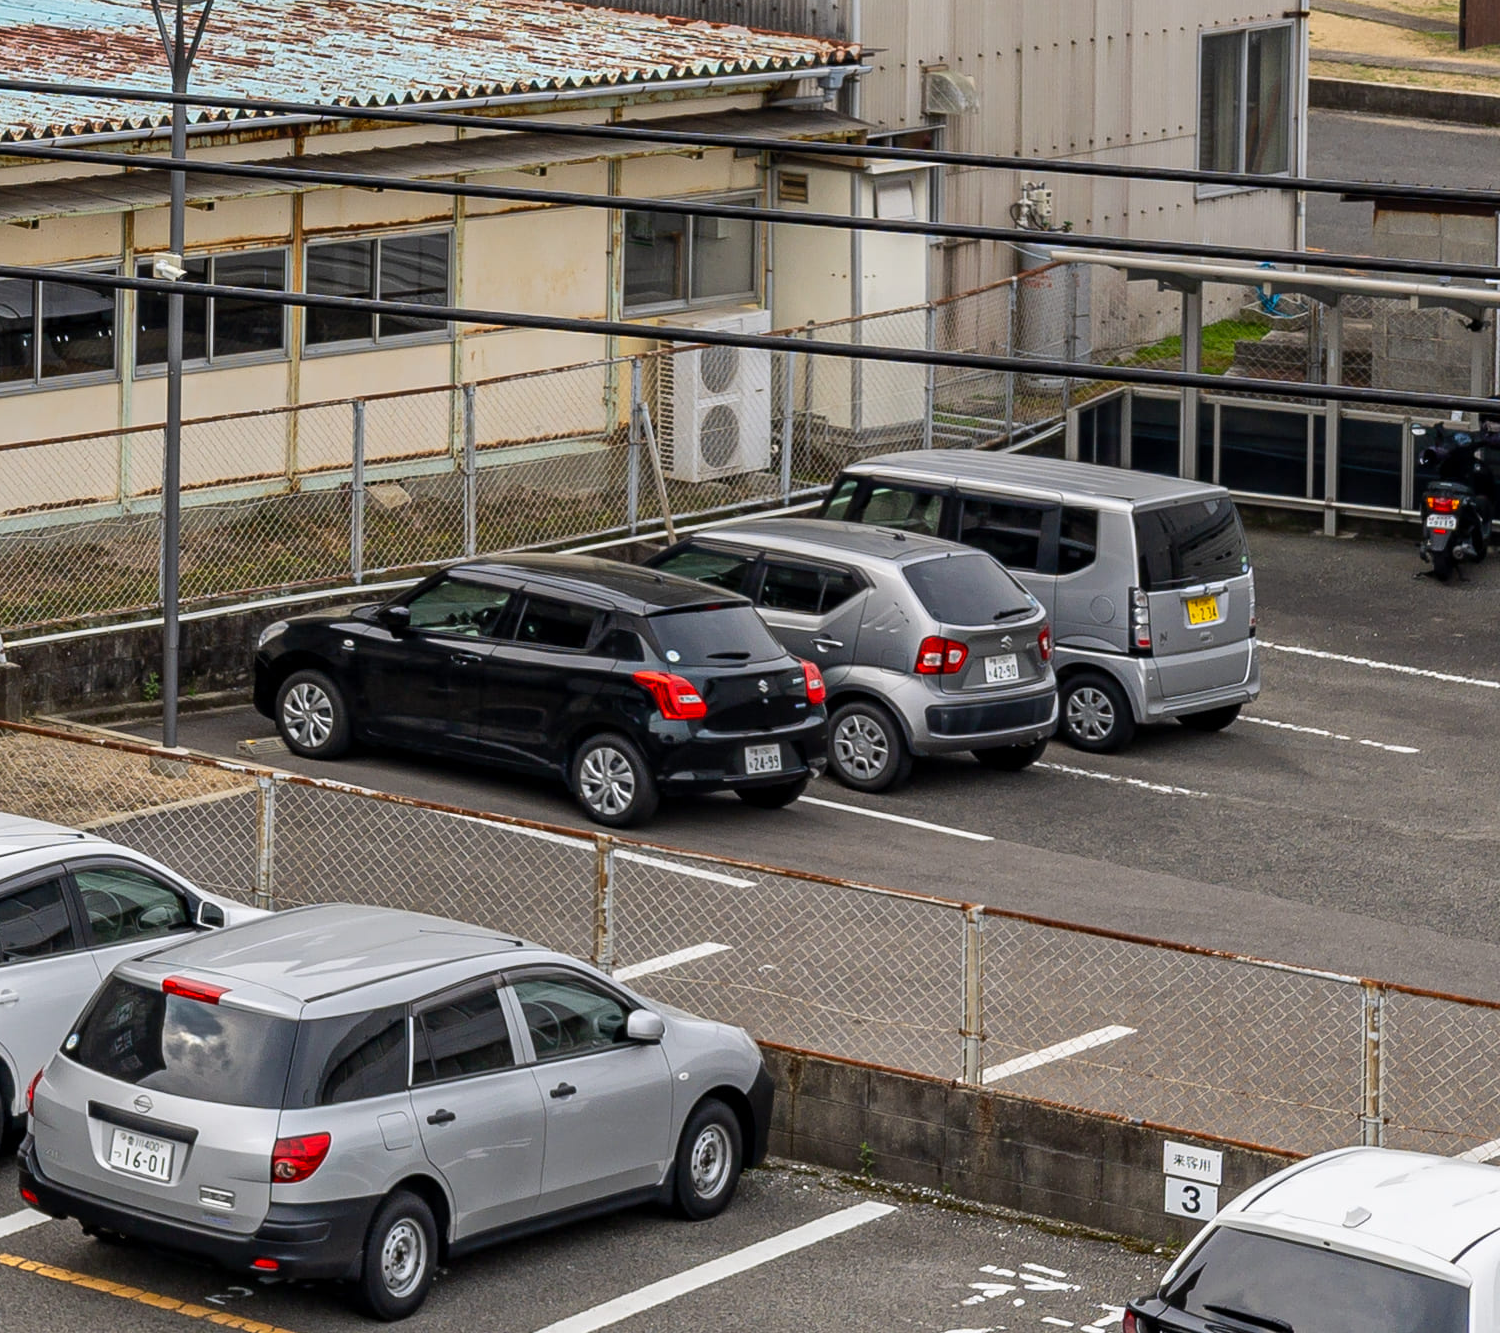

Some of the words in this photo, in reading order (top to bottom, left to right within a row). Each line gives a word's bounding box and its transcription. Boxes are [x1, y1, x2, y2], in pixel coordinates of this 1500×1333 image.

[754, 754, 779, 771] 24-99
[125, 1147, 165, 1176] 16-01
[1181, 1185, 1201, 1214] 3
